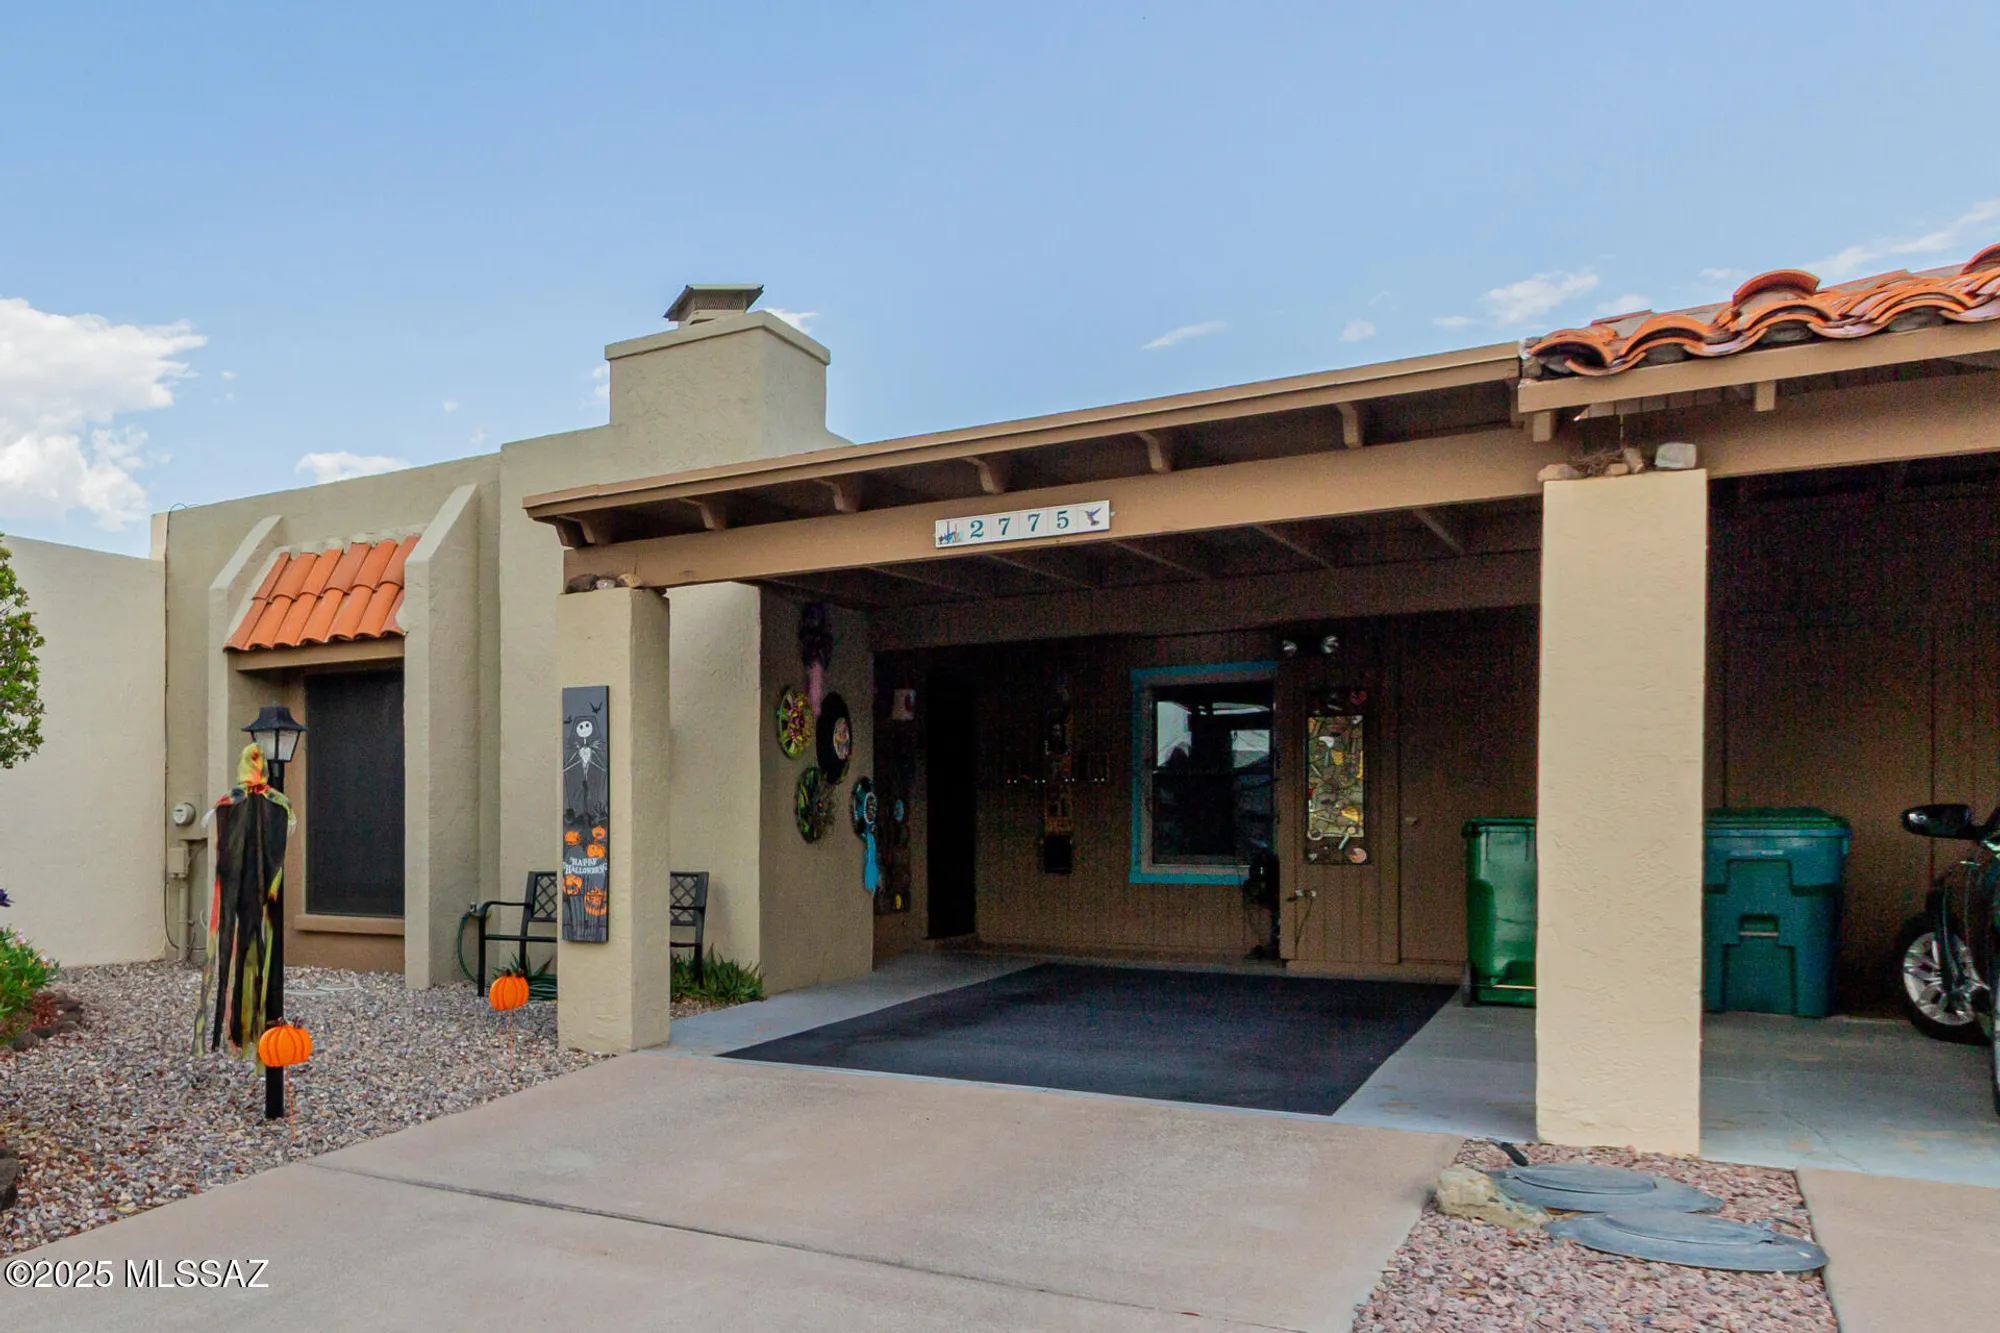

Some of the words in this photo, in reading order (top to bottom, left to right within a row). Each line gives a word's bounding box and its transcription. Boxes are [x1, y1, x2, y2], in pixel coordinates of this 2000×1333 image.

[969, 510, 1069, 539] 2775
[570, 857, 598, 867] HAPPY
[564, 863, 606, 874] HALLOWEEN
